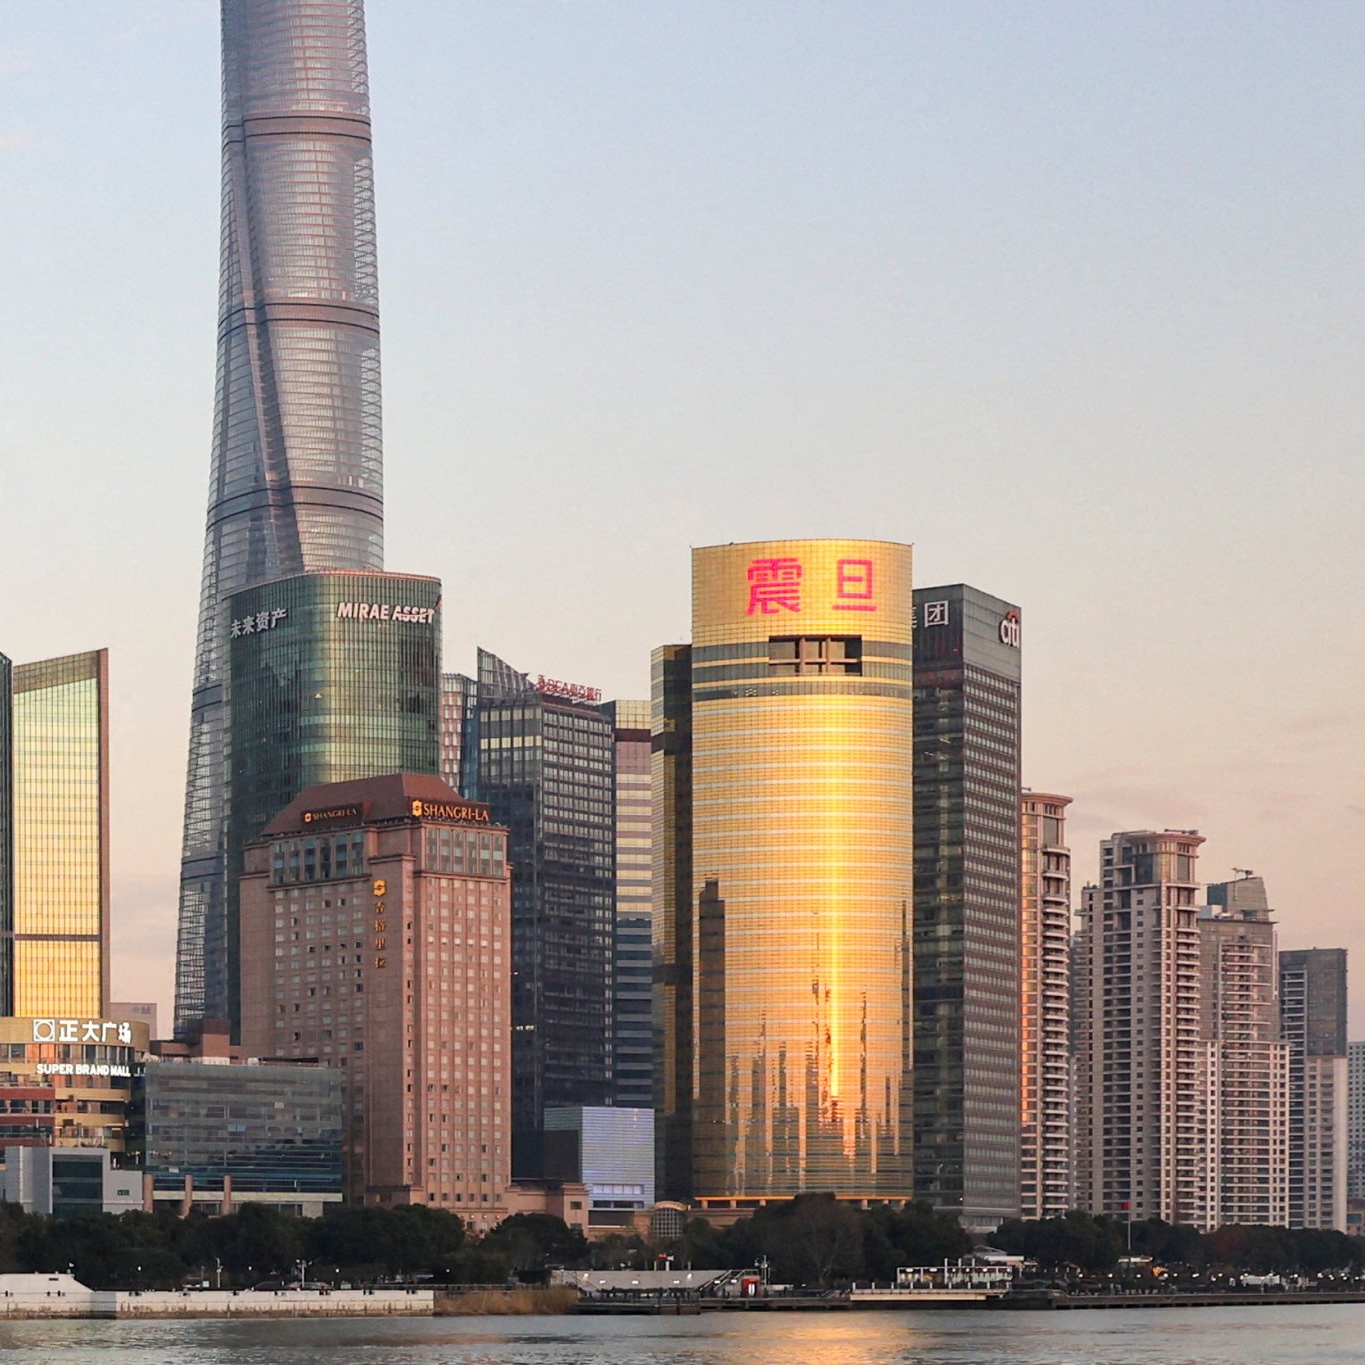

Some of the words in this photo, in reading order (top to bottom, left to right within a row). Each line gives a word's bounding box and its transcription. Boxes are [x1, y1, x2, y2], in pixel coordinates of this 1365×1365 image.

[745, 557, 878, 616] 震旦
[230, 607, 287, 639] 未来资产
[337, 602, 389, 621] MIRAE
[392, 605, 436, 624] ASSET
[912, 600, 950, 628] 团
[423, 803, 490, 822] SHANGRI-LA
[58, 1020, 131, 1044] 正大广场
[36, 1063, 73, 1075] SUPER
[75, 1064, 109, 1076] BRAND
[110, 1065, 131, 1077] MALL
